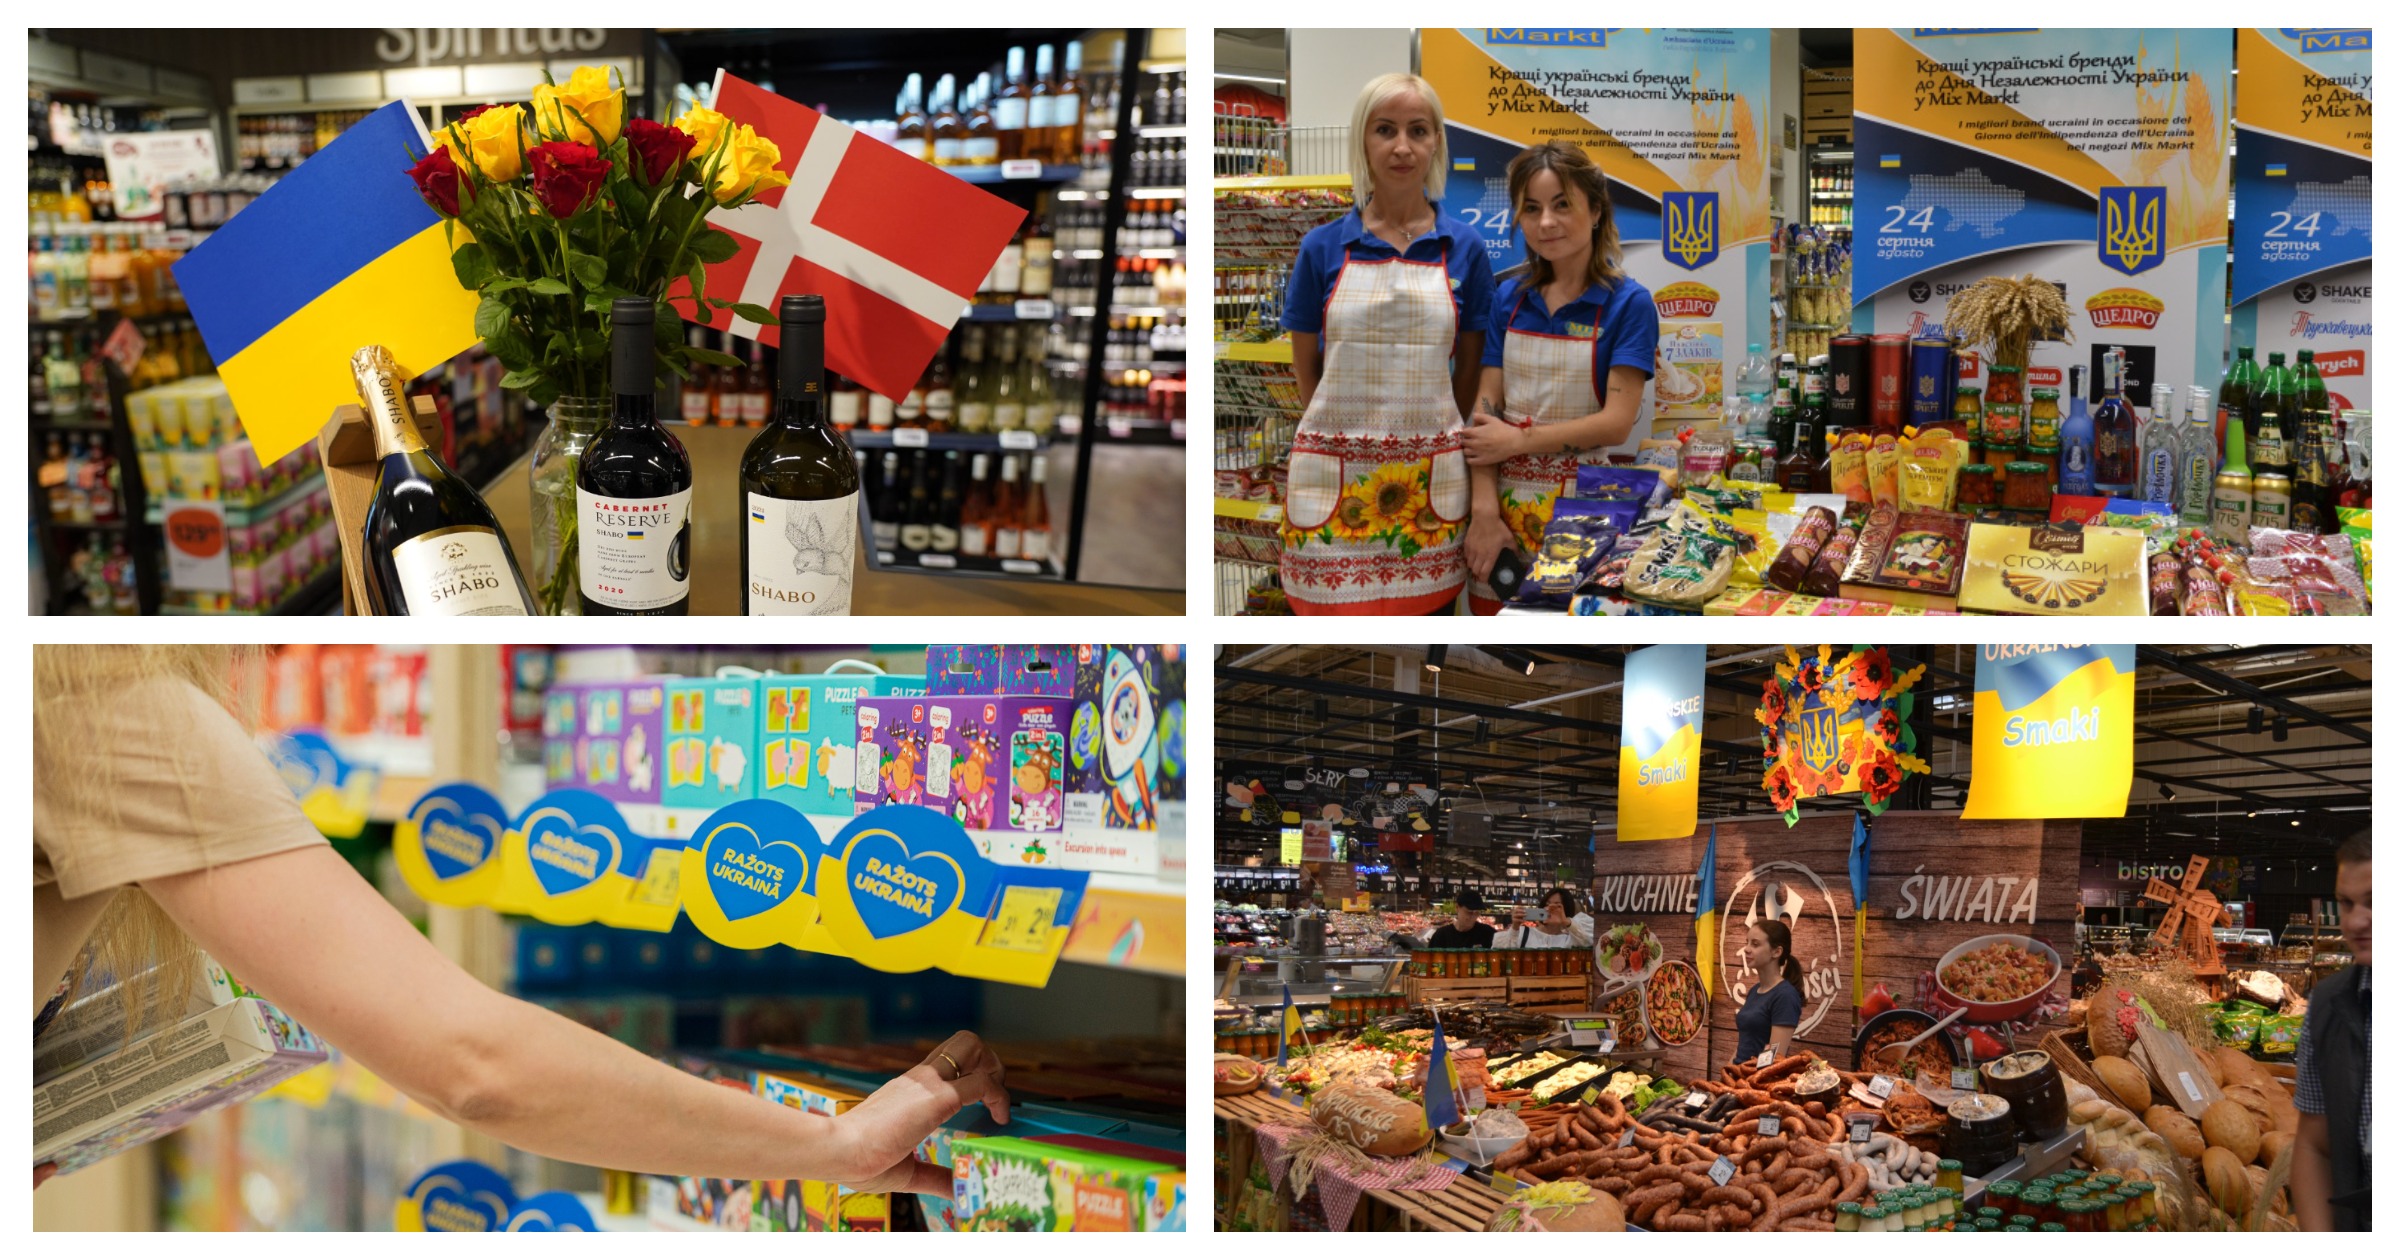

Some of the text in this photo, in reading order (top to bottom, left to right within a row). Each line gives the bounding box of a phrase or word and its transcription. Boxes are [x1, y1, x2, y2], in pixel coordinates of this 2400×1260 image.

[1491, 28, 1602, 43] Markt
[1916, 52, 2136, 77] Кращі українські бренди
[1489, 66, 1691, 88] Кращі українські бренди
[1915, 69, 2190, 93] до Дня Незалежності України
[2303, 72, 2358, 91] Кращі
[1488, 83, 1736, 105] до Дня Незалежності України
[1929, 92, 1962, 106] Mix
[1966, 88, 2020, 105] Markt
[2302, 89, 2363, 106] до Дня
[1502, 98, 1535, 113] Mix
[1538, 98, 1590, 114] Markt
[2316, 104, 2351, 118] Mix
[1965, 118, 2008, 130] migliori
[2012, 118, 2045, 127] brand
[2048, 118, 2089, 127] ucraini
[2092, 117, 2103, 126] in
[2107, 116, 2169, 126] occasione
[2172, 116, 2191, 125] del
[1538, 128, 1580, 138] migliori
[1582, 128, 1613, 136] brand
[1615, 129, 1652, 137] ucraini
[1655, 129, 1665, 137] in
[1667, 130, 1719, 138] occasione
[1974, 129, 2195, 140] Giorno dell'Indipendenza dell'Ucraina
[1585, 139, 1678, 150] dell'Indipendenza
[1680, 141, 1741, 150] dell'Ucraina
[2088, 142, 2128, 152] negozi
[2131, 142, 2153, 150] Mix
[2157, 141, 2195, 150] Markt
[1652, 152, 1684, 162] negozi
[1688, 152, 1707, 160] Mix
[1710, 152, 1741, 160] Markt
[1880, 205, 1935, 233] 24
[2264, 211, 2321, 238] 24
[1876, 237, 1936, 250] серпня
[2261, 241, 2321, 255] серпня
[1877, 248, 1925, 260] agosto
[2261, 252, 2310, 263] agosto
[1659, 299, 1714, 316] ЩЕДРО
[2091, 308, 2156, 326] ЩЕДРО
[379, 377, 405, 424] SHABO
[595, 502, 668, 512] CABERNET
[596, 512, 671, 527] RESERVE
[2215, 512, 2240, 527] 1715
[596, 529, 624, 538] SHABO
[2003, 554, 2109, 575] СТОЖАРИ
[431, 577, 499, 603] SHABO
[598, 585, 624, 594] 2020
[751, 582, 816, 604] SHABO
[825, 686, 857, 703] PUZZLE
[860, 713, 877, 724] coloring
[932, 713, 949, 725] coloring
[1022, 713, 1053, 724] PUZZLE
[2003, 706, 2099, 747] Smaki
[1305, 766, 1345, 789] SERY
[1637, 758, 1687, 787] Smaki
[1065, 841, 1093, 853] Excursion
[1095, 844, 1107, 854] into
[723, 848, 785, 881] RAŽOTS
[2118, 861, 2184, 880] bistro
[712, 862, 782, 899] UKRAINĀ
[865, 857, 938, 897] RAŽOTS
[854, 872, 935, 918] UKRAINĀ
[1601, 875, 1699, 914] KUCHNIE
[1896, 864, 2039, 925] ŚWIATA
[1077, 1190, 1124, 1219] PUZZLE
